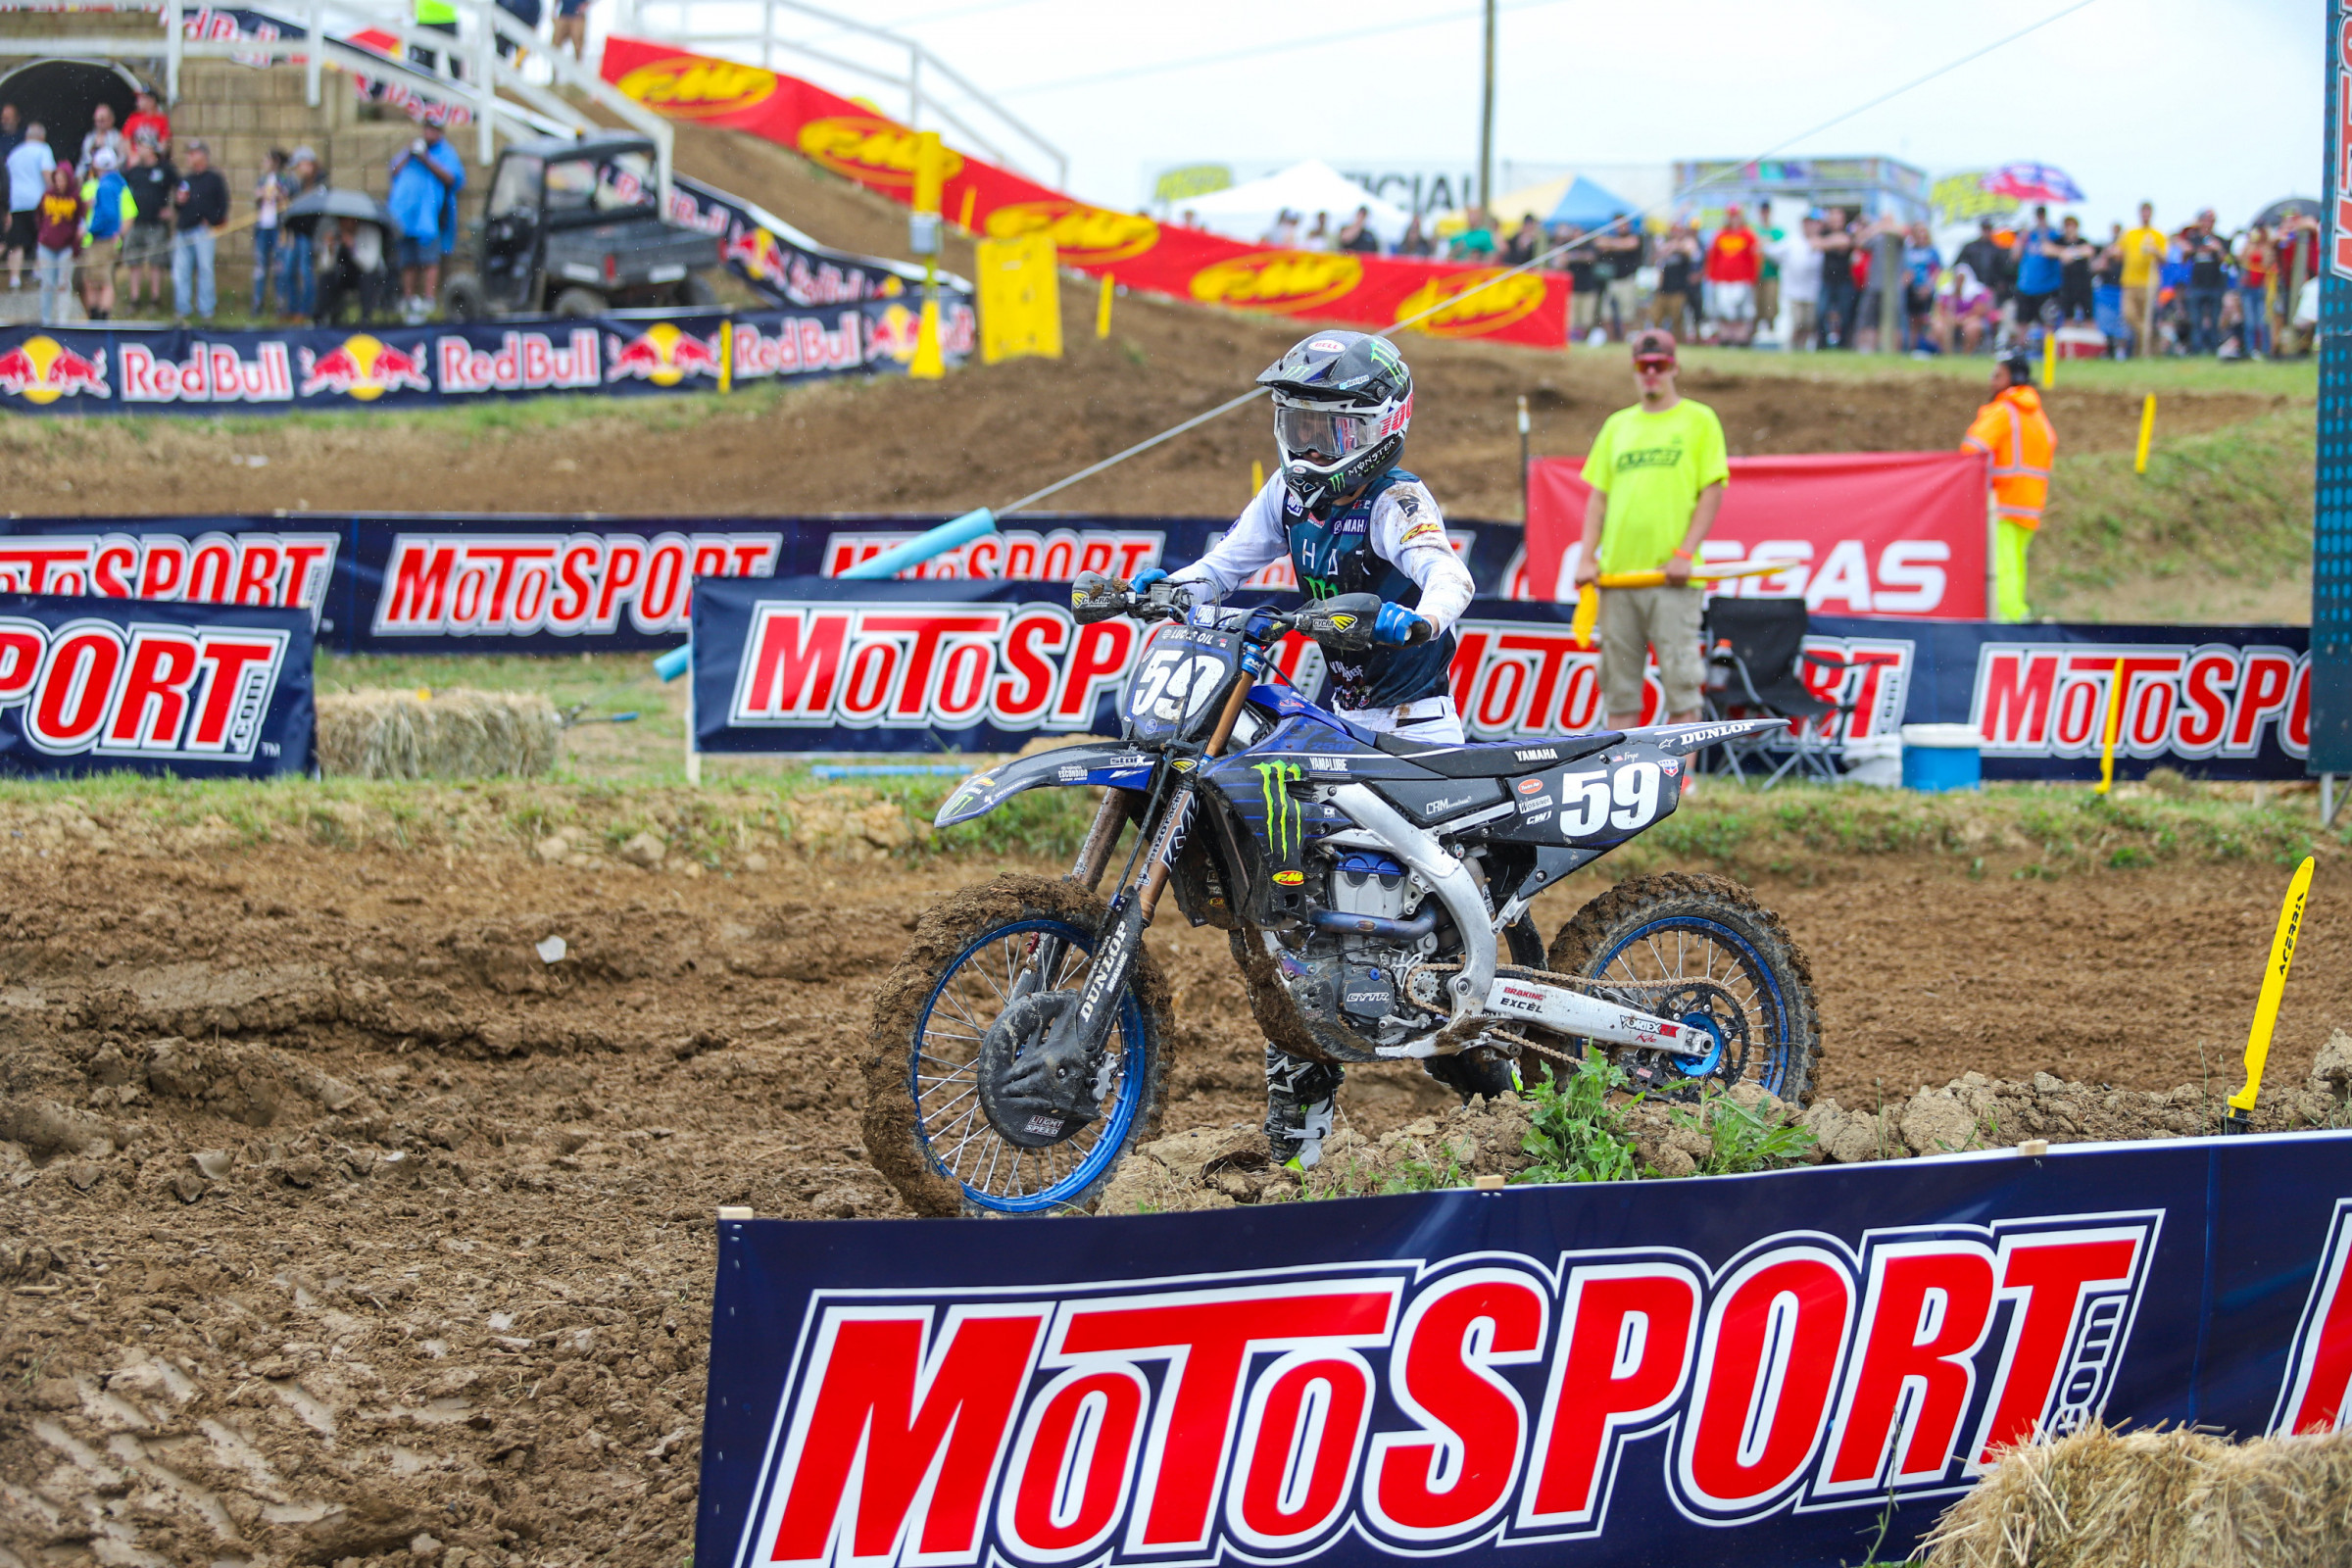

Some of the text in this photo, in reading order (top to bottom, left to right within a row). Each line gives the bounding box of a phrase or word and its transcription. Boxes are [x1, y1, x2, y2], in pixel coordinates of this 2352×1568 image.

[1197, 632, 1214, 645] OIL
[1131, 649, 1226, 720] 59
[1680, 722, 1755, 746] DUNLOP
[1515, 748, 1558, 761] YAMAHA
[1426, 798, 1449, 814] CRM
[1560, 761, 1661, 838] 59
[1080, 921, 1127, 1022] DUNLOP
[1347, 992, 1390, 1003] GYTR
[1503, 986, 1544, 1002] BRAKING
[1499, 997, 1544, 1014] EXCEL
[1620, 1015, 1660, 1033] VORTEX
[1031, 1115, 1064, 1127] LIGHT
[1025, 1124, 1059, 1136] SPEED
